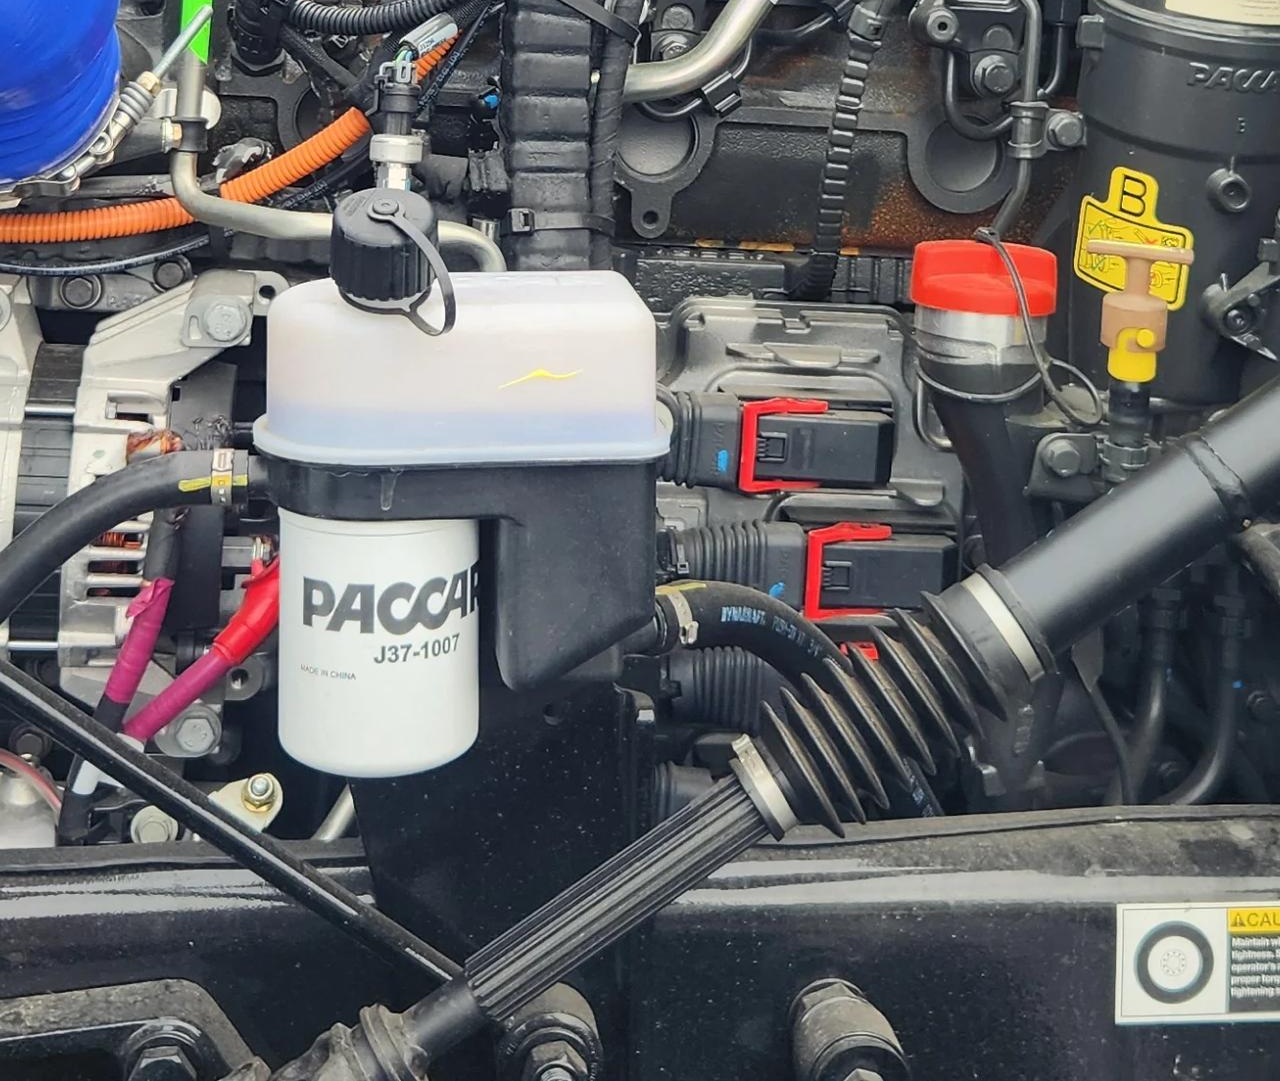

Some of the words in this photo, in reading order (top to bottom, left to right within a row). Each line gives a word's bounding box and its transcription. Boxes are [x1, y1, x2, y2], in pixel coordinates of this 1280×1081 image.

[1120, 174, 1148, 218] B
[373, 633, 461, 665] J37-1007
[300, 663, 319, 676] MADE
[321, 667, 329, 679] IN
[330, 669, 357, 681] CHINA
[1232, 936, 1270, 948] Maintain
[1232, 949, 1274, 961] tightness.
[1232, 961, 1276, 973] operator's
[1232, 975, 1261, 987] proper
[1231, 986, 1275, 999] tightening
